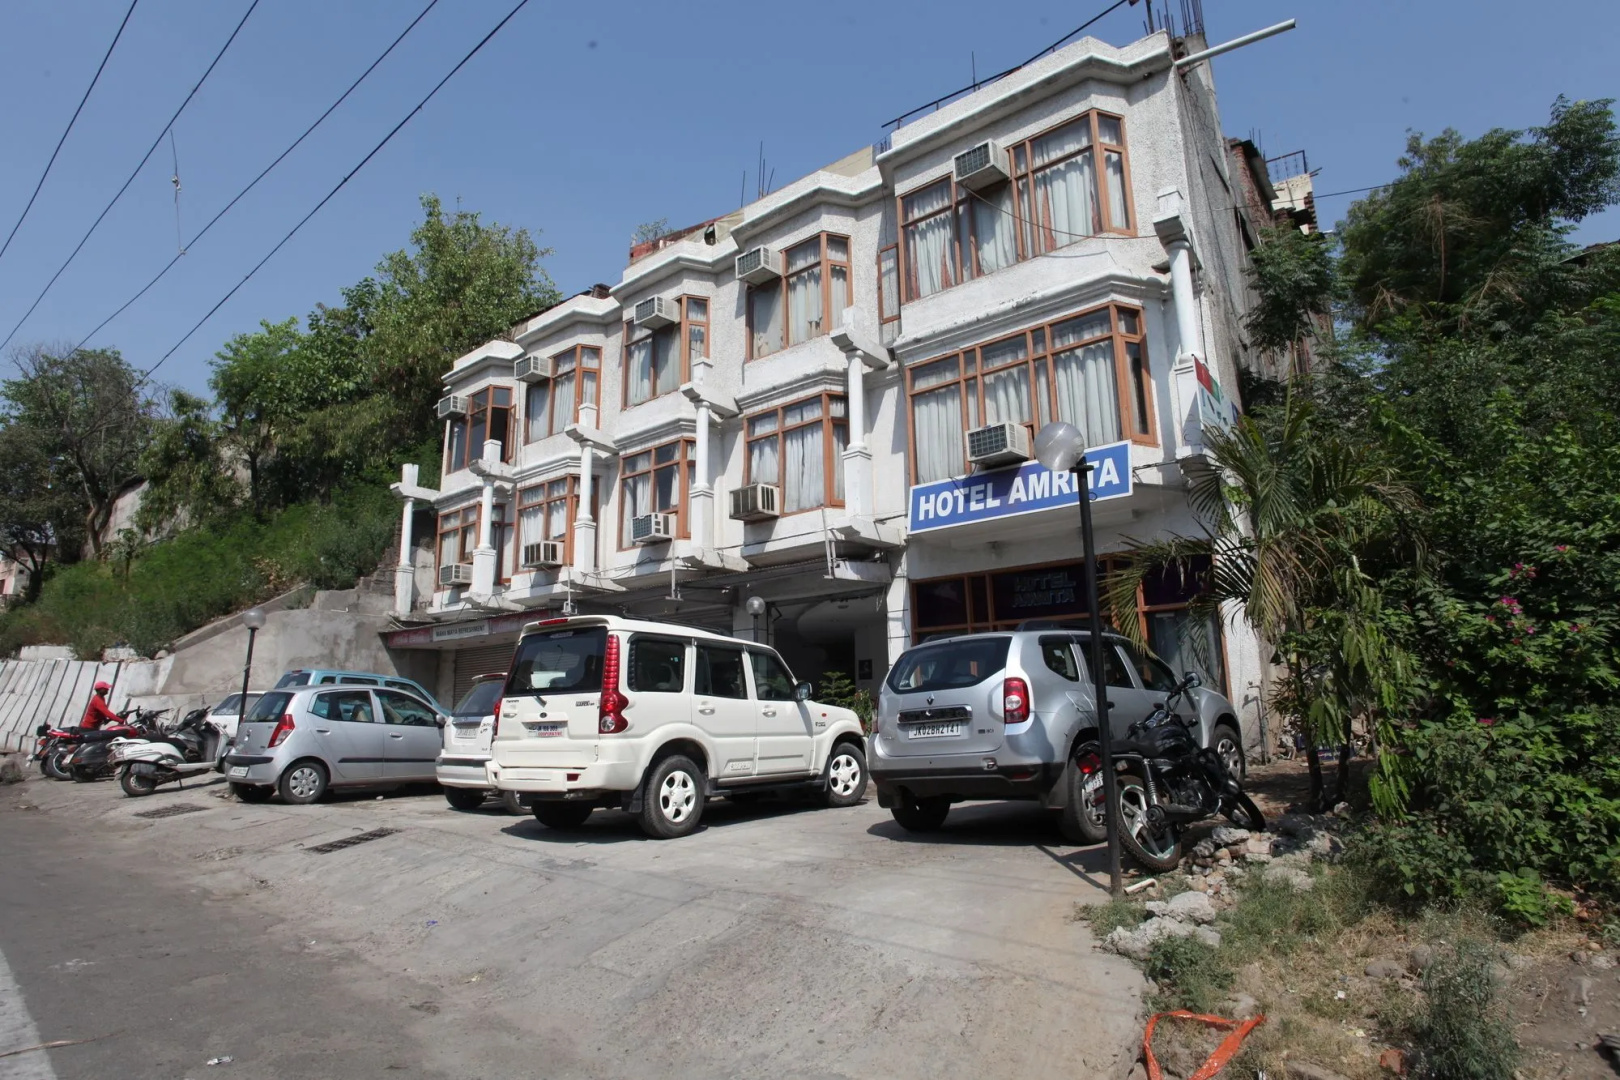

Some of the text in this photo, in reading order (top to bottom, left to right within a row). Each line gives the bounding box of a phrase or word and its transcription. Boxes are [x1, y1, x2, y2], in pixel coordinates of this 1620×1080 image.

[919, 457, 1120, 521] HOTEL AMRITA
[1014, 571, 1077, 592] HOTEL
